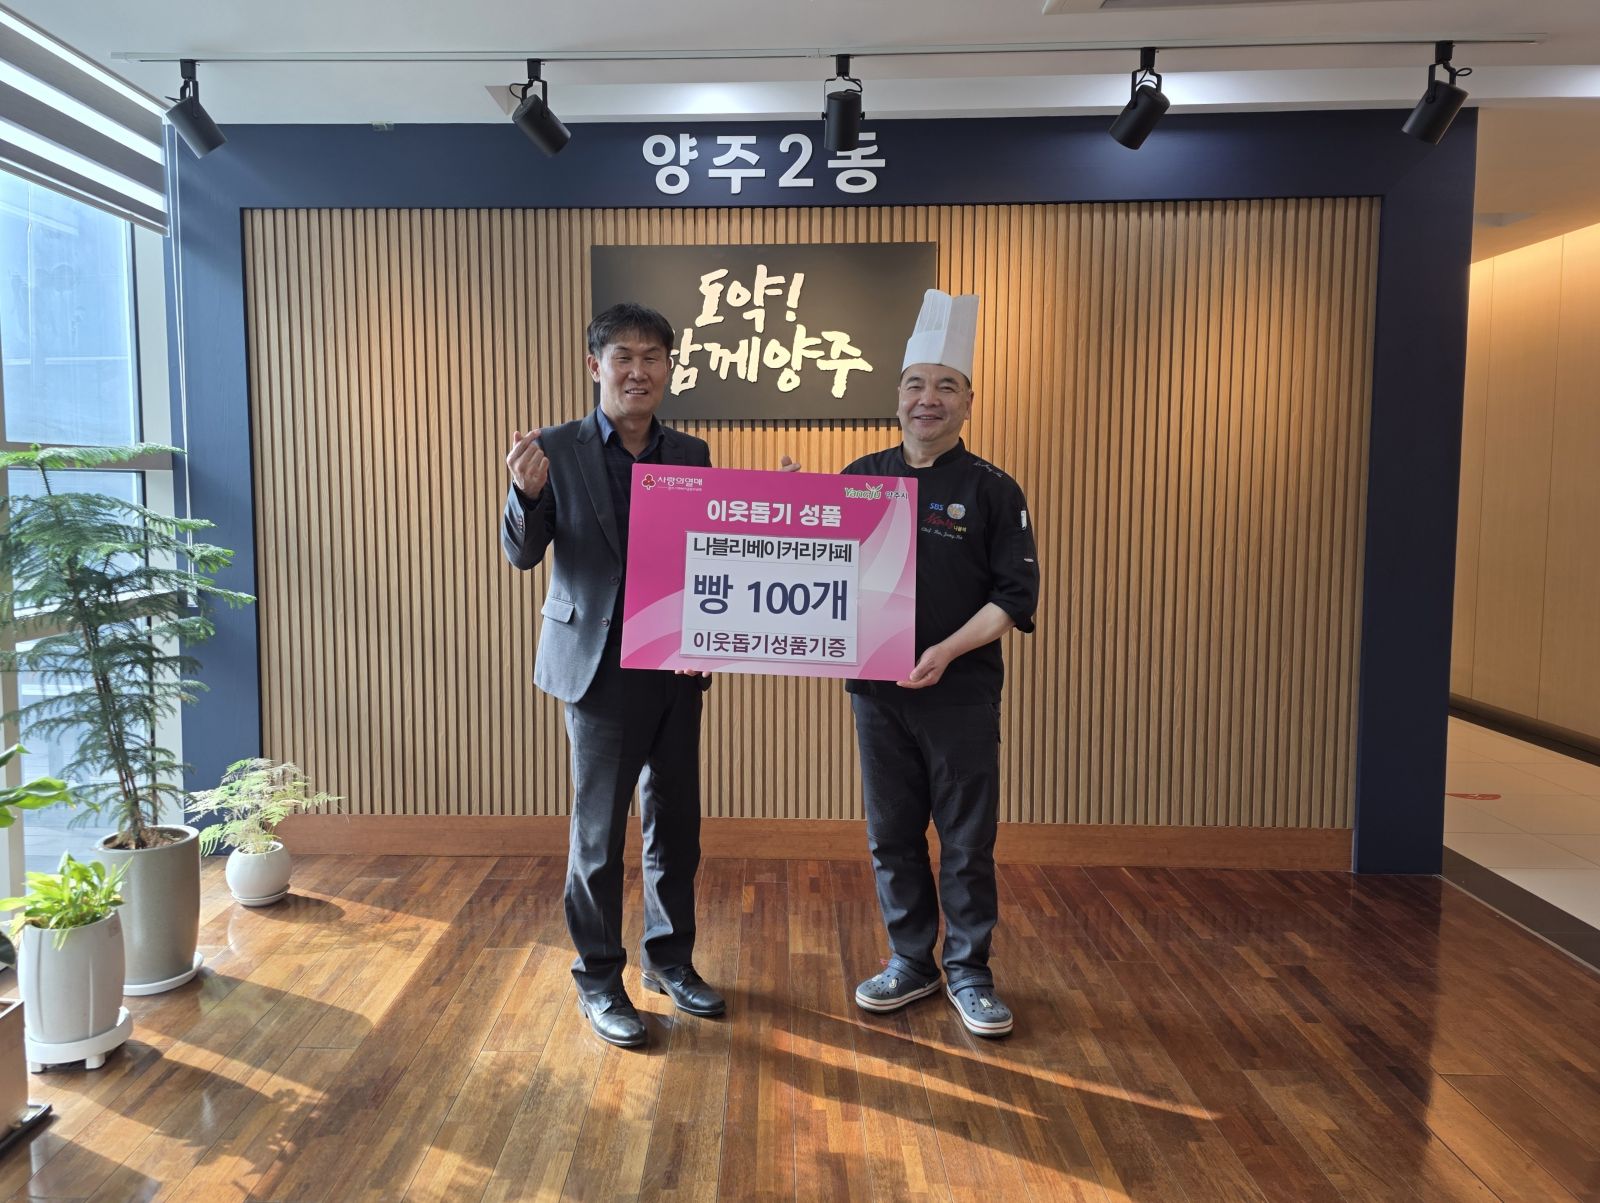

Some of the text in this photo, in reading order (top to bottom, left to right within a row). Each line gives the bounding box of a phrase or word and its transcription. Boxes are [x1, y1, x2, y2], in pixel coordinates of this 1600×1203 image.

[642, 131, 886, 195] 양주2동
[695, 264, 805, 333] 도약!
[707, 499, 842, 527] 이웃돕기 성품
[929, 502, 945, 511] SBS
[693, 536, 853, 563] 나블리베이커리카페
[693, 574, 848, 621] 빵 100개
[693, 631, 847, 658] 이웃돕기성품기증
